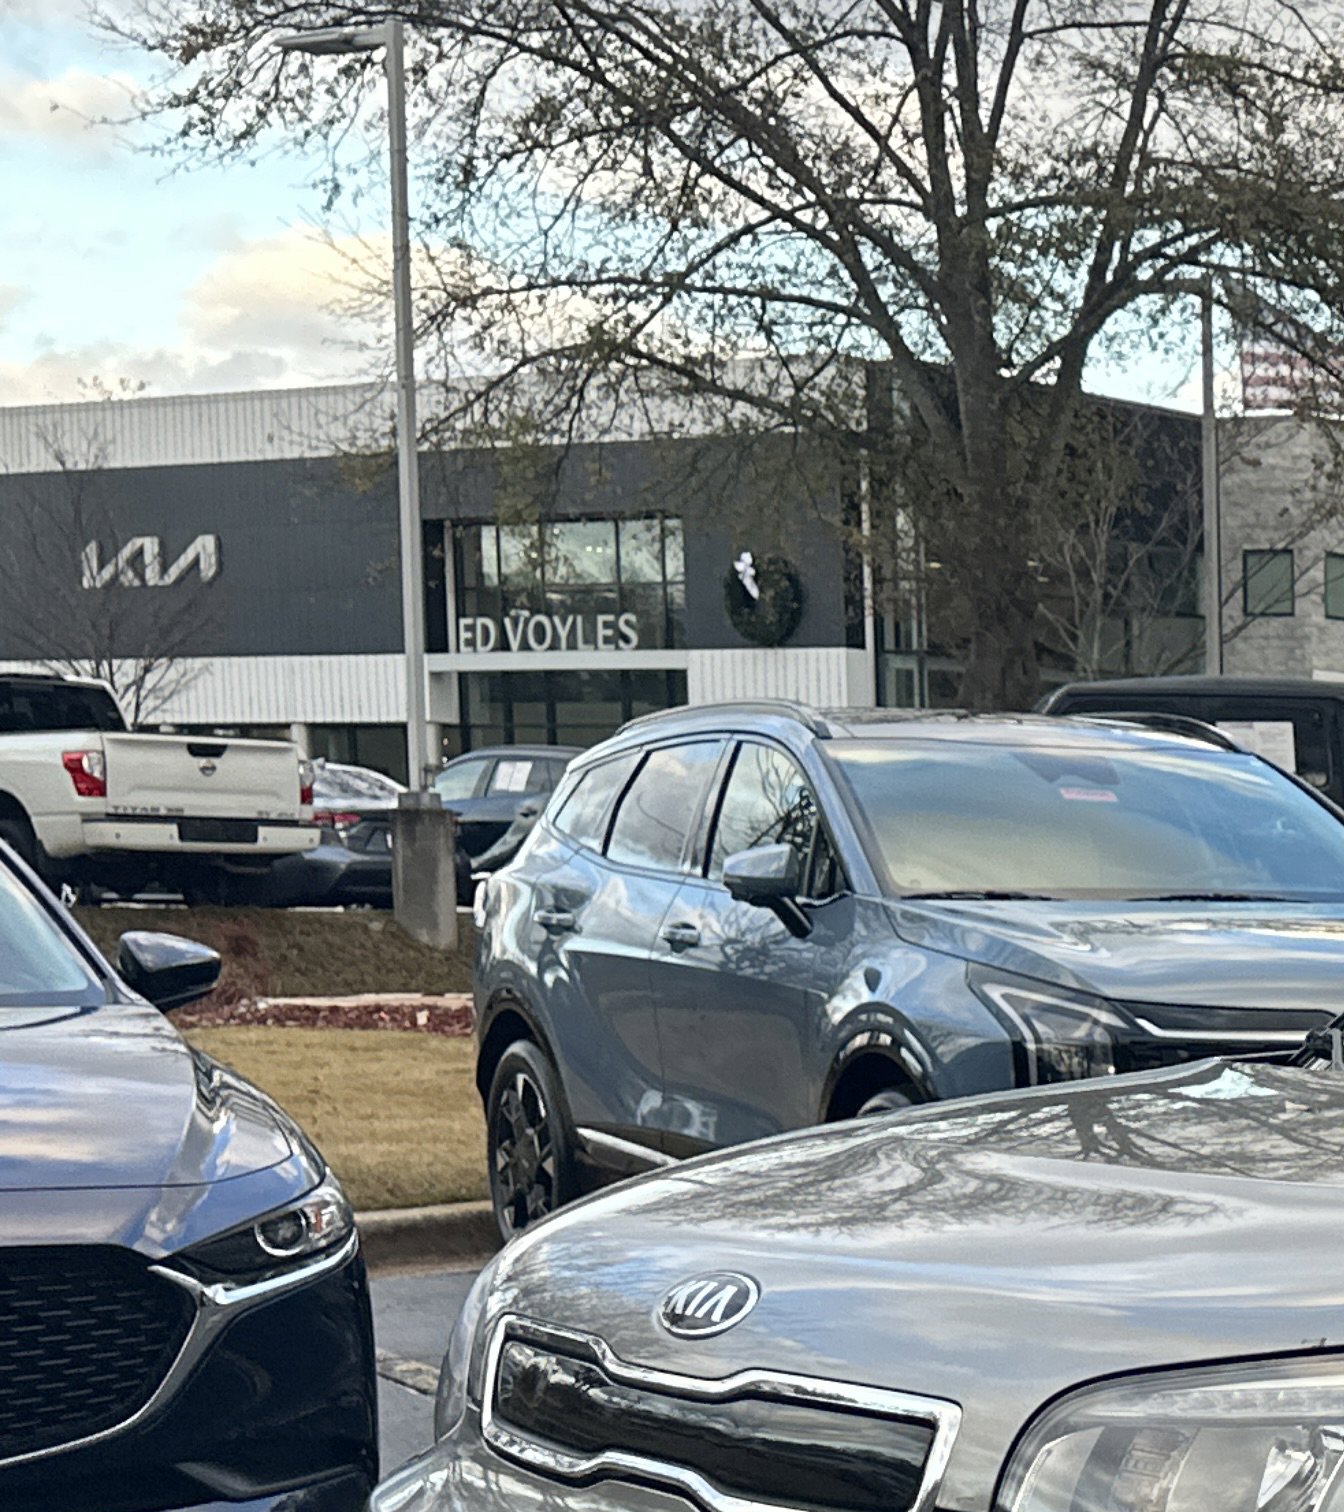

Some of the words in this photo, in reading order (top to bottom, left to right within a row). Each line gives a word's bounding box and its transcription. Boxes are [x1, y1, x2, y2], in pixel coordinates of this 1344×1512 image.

[80, 533, 217, 590] KIA
[458, 616, 497, 653] ED
[504, 612, 639, 652] VOYLES
[664, 1279, 739, 1323] KIA
